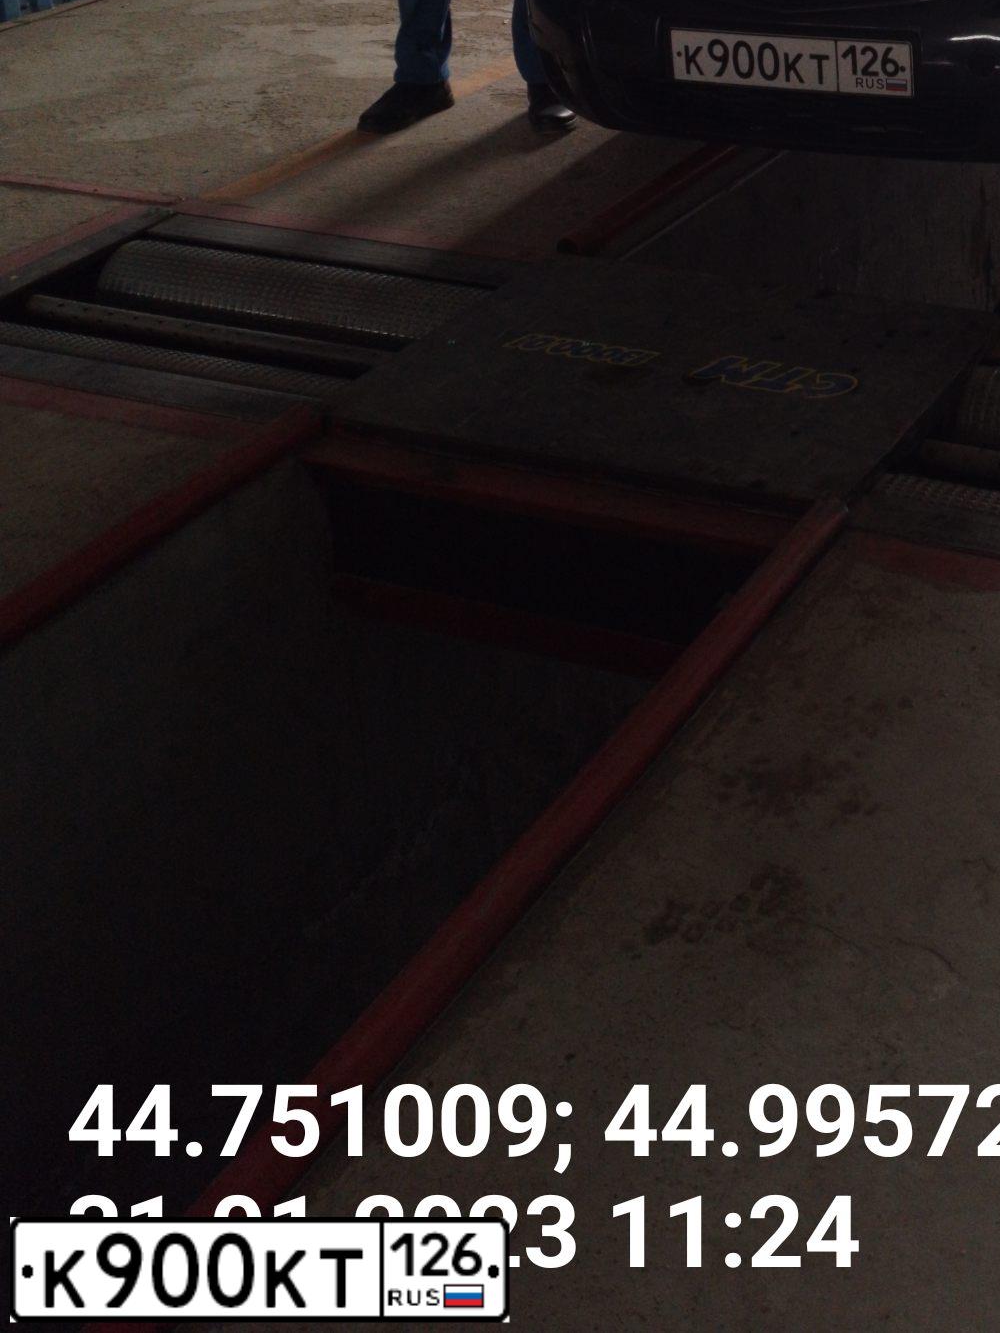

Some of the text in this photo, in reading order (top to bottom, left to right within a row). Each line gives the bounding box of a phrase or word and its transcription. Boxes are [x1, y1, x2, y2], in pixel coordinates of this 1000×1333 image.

[684, 38, 900, 85] К900КТ 126
[855, 77, 885, 90] RUS
